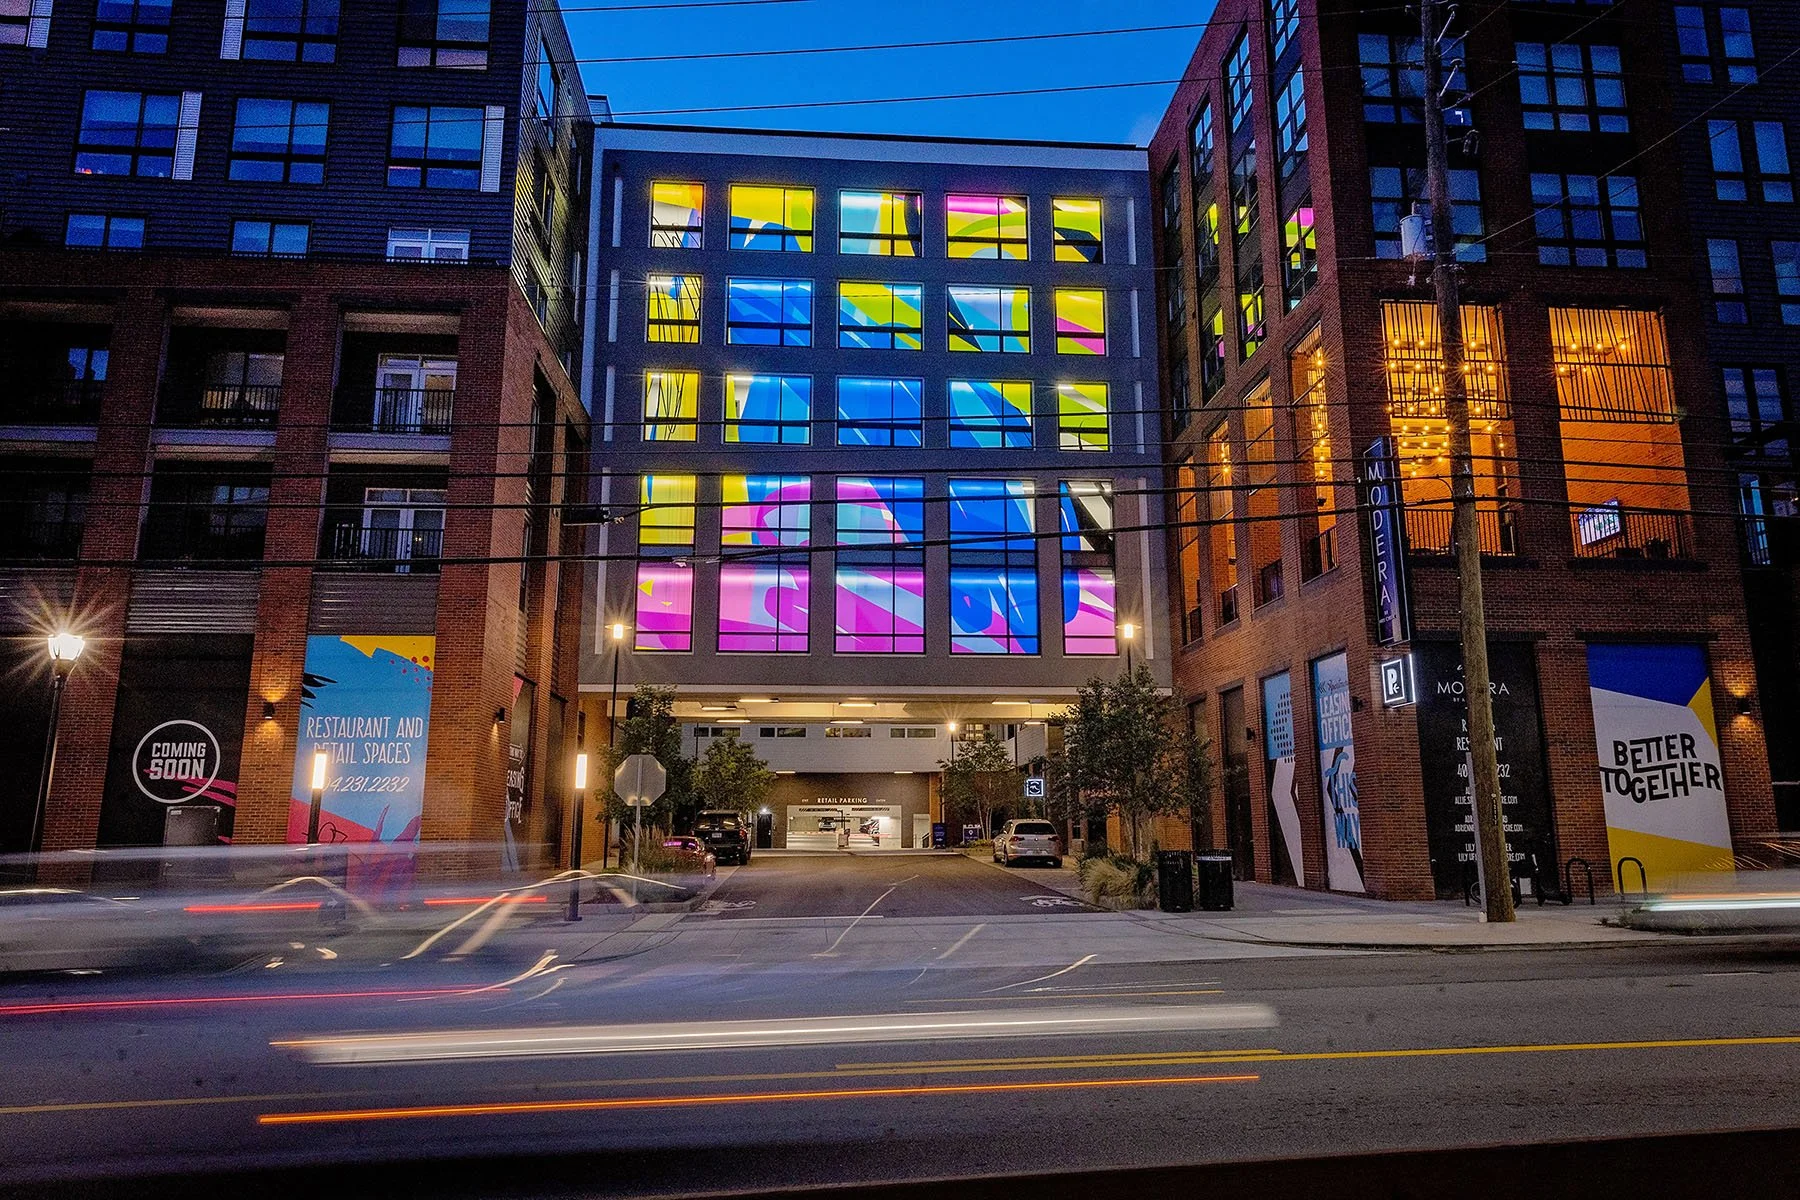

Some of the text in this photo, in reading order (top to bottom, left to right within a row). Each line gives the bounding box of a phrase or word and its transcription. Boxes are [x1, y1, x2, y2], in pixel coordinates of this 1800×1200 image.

[1368, 462, 1392, 607] MODERA
[1386, 668, 1398, 696] P
[1437, 681, 1510, 695] MORA
[306, 716, 424, 739] RESTAURANT AND
[151, 742, 207, 758] COMING
[362, 742, 412, 765] SPACES
[1613, 733, 1697, 773] BETTER
[149, 758, 206, 780] SOON
[309, 775, 410, 793] 4.231.2232
[1599, 762, 1722, 804] TOGETHER
